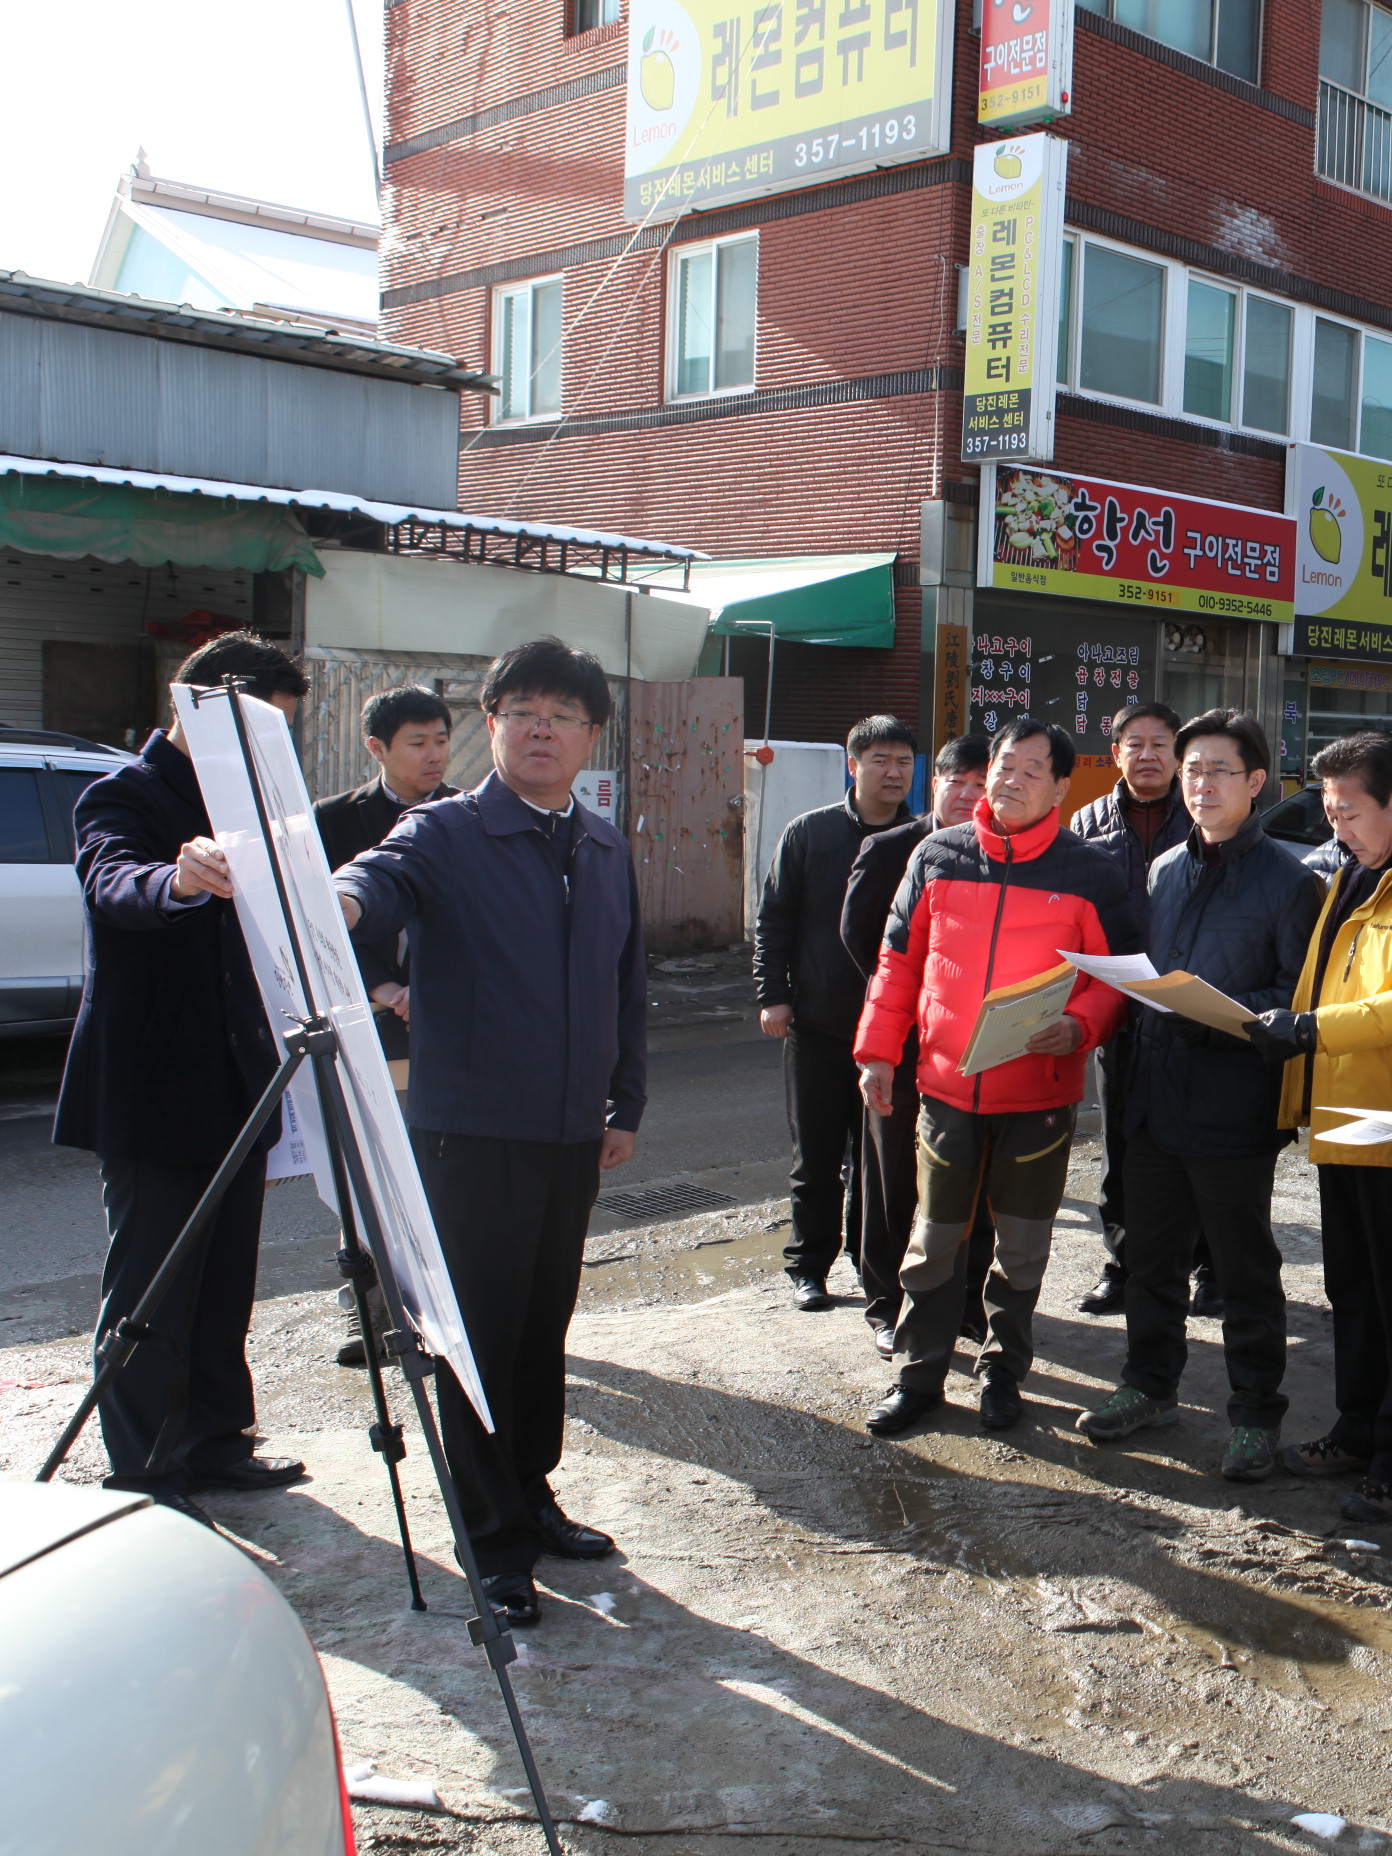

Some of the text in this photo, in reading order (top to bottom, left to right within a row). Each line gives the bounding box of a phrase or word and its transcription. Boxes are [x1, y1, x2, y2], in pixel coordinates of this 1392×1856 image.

[984, 31, 1047, 82] 구이전문점
[981, 84, 1041, 111] 352-9151
[633, 120, 677, 147] Lemon
[795, 115, 917, 168] 357-1193
[988, 182, 1024, 195] Lemon
[981, 208, 989, 218] 또
[991, 203, 1007, 215] 다른
[985, 218, 1018, 383] 레몬컴퓨터
[966, 432, 1027, 454] 357-1193
[1376, 474, 1386, 489] 또
[1072, 488, 1281, 583] 학선 구이전문점
[1009, 570, 1047, 586] 일반음식점
[1301, 564, 1342, 588] Lemon
[1118, 583, 1173, 604] 352-9151
[975, 633, 1032, 658] 나고구이
[1077, 641, 1140, 665] 아나고조림
